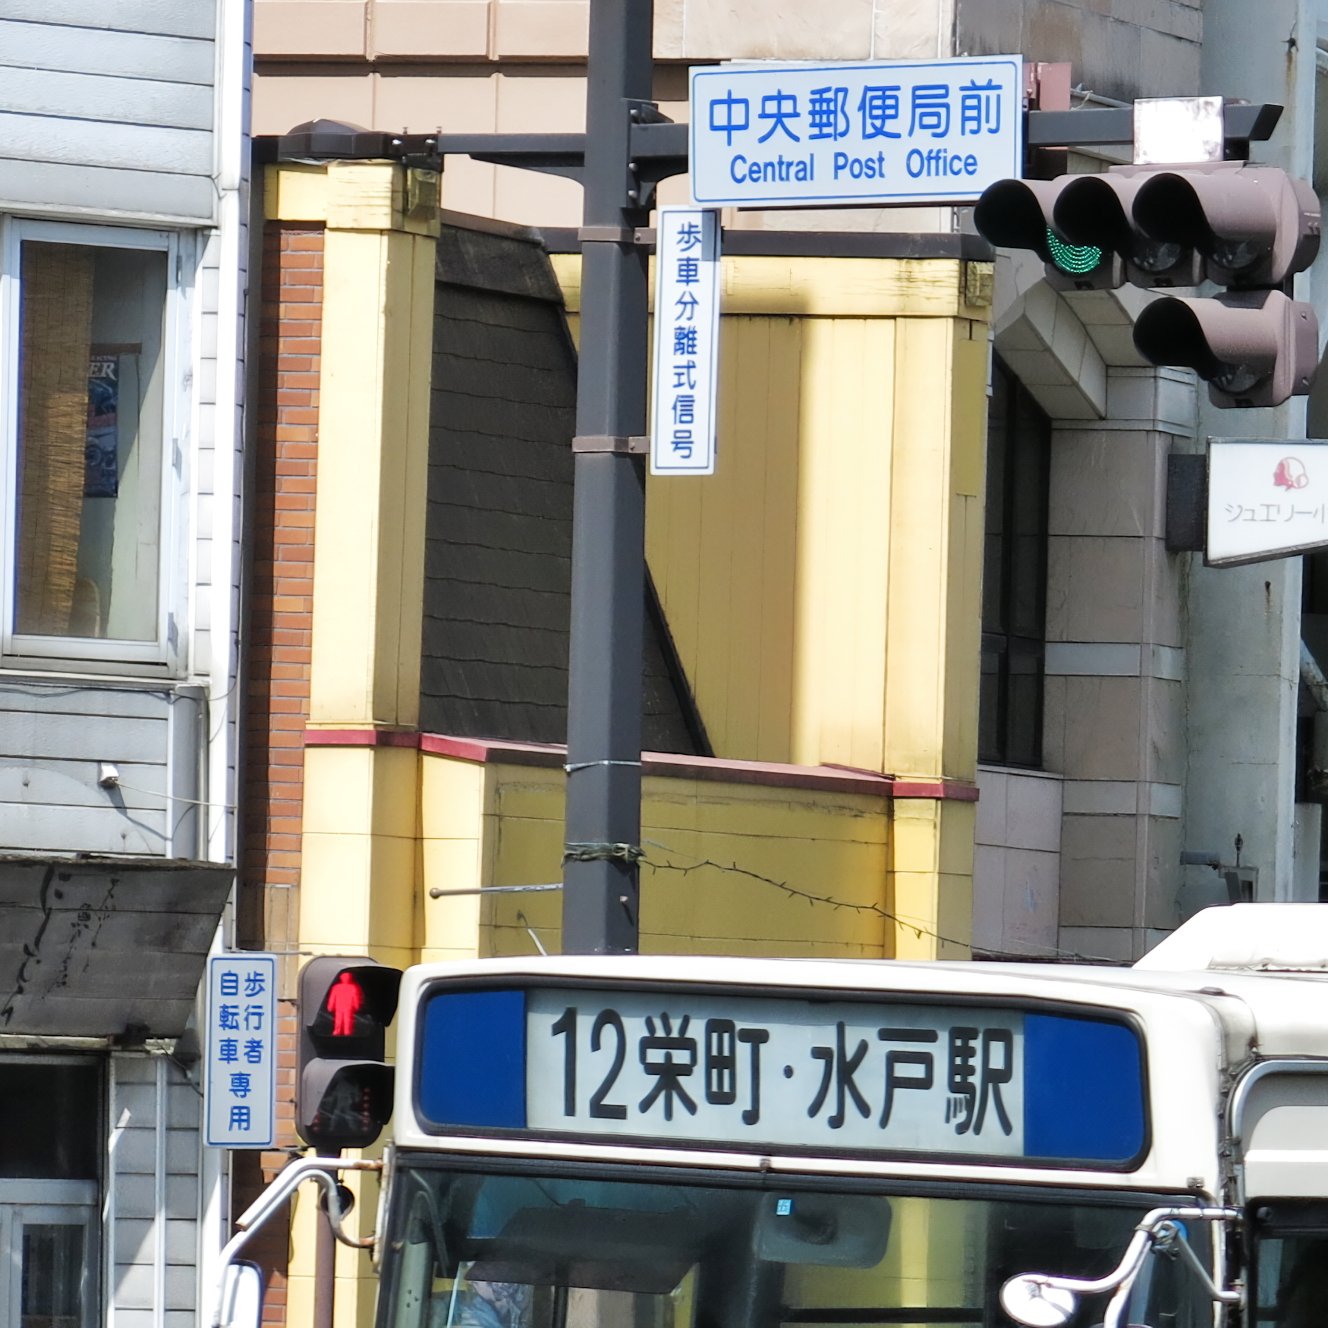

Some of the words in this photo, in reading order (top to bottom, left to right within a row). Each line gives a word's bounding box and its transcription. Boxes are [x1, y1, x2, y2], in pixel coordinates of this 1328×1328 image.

[708, 78, 1004, 147] 中央郵便局前
[730, 153, 815, 184] Central
[833, 151, 886, 181] Post
[905, 148, 978, 178] Office
[670, 221, 703, 459] 歩車分離式信号
